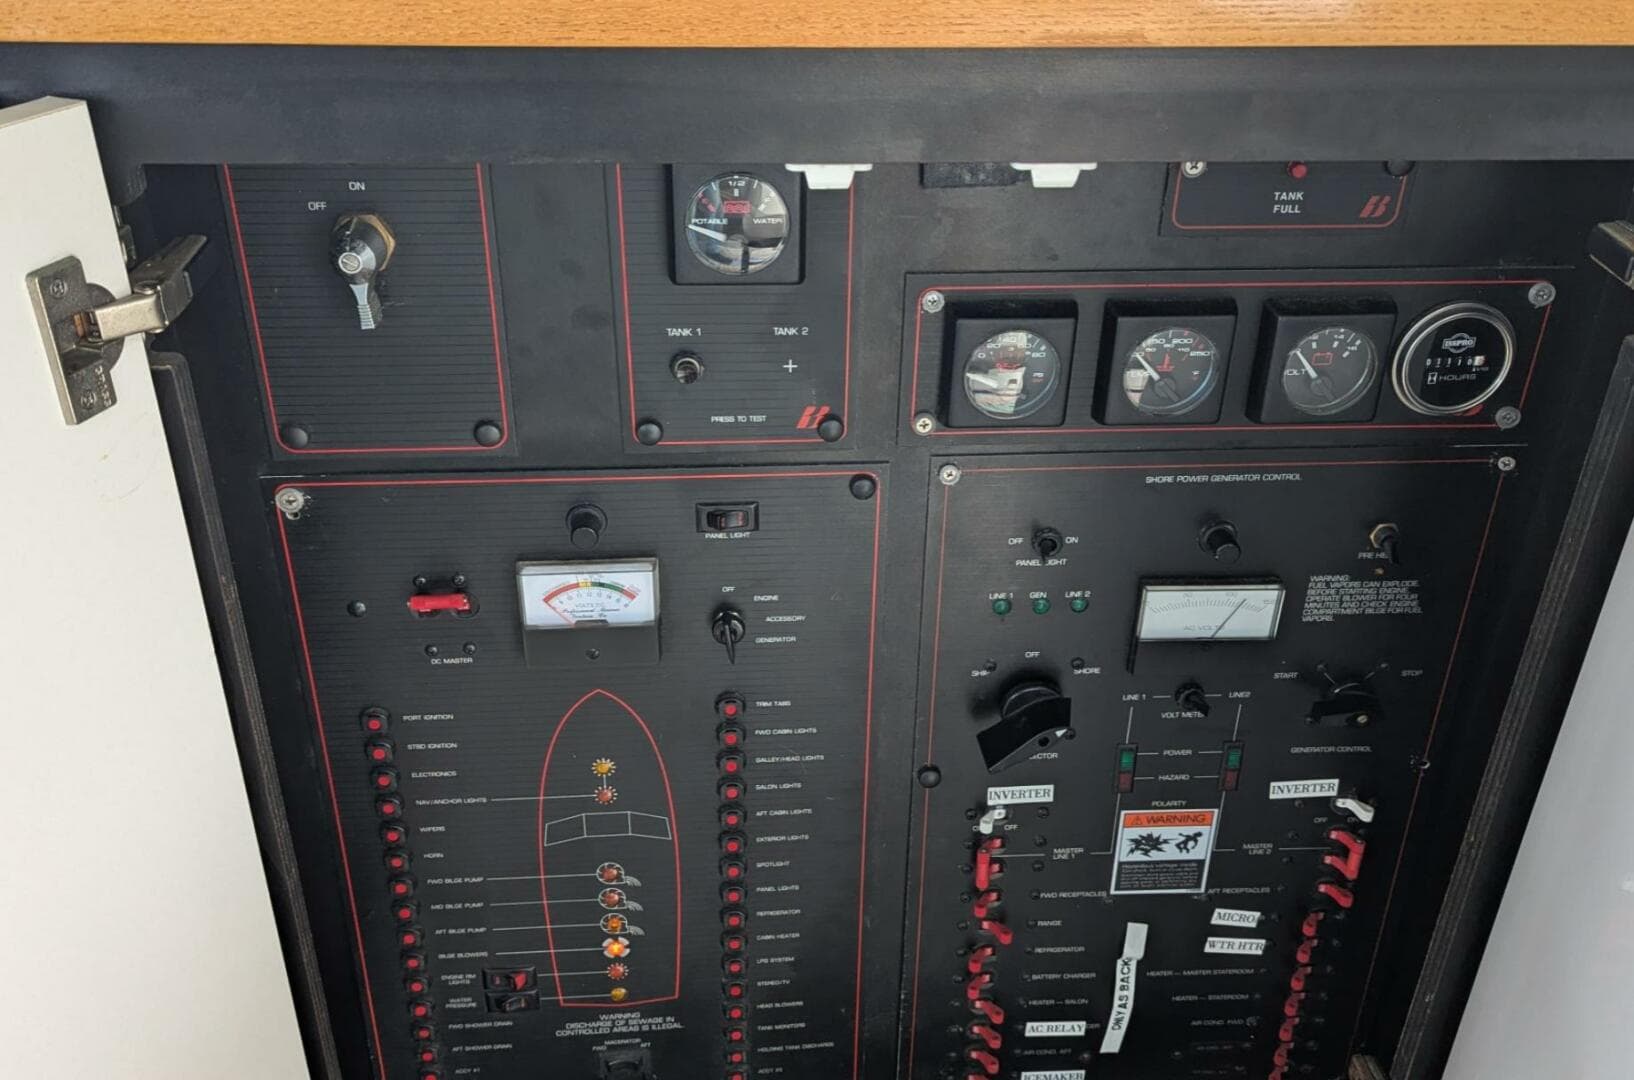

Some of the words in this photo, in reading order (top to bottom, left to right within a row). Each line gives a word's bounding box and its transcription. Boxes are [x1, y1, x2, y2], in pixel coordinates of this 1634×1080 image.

[349, 181, 365, 191] ON
[1274, 191, 1304, 201] TANK
[308, 201, 327, 211] OFF
[1273, 204, 1301, 214] FULL
[666, 328, 692, 336] TANK
[773, 327, 798, 336] TANK
[802, 327, 809, 336] 2
[711, 415, 735, 423] PRESS
[737, 415, 748, 423] TO
[1146, 475, 1174, 484] SHORE
[1177, 475, 1209, 483] POWER
[1210, 474, 1260, 482] GENERATOR
[1263, 473, 1302, 481] CONTROL
[1271, 783, 1336, 795] INVERTER
[988, 789, 1051, 801] INVERTER
[1146, 814, 1205, 824] WARNING
[1215, 912, 1256, 923] MICRO
[1208, 940, 1233, 950] WTR
[1238, 941, 1264, 951] HTR
[1119, 957, 1132, 992] BACK
[1118, 995, 1129, 1009] AS
[600, 1012, 640, 1020] WARNING
[565, 1021, 613, 1029] DISCHARGE
[1028, 1025, 1043, 1033] AC
[1046, 1024, 1084, 1033] RELAY
[555, 1028, 610, 1037] CONTROLLED
